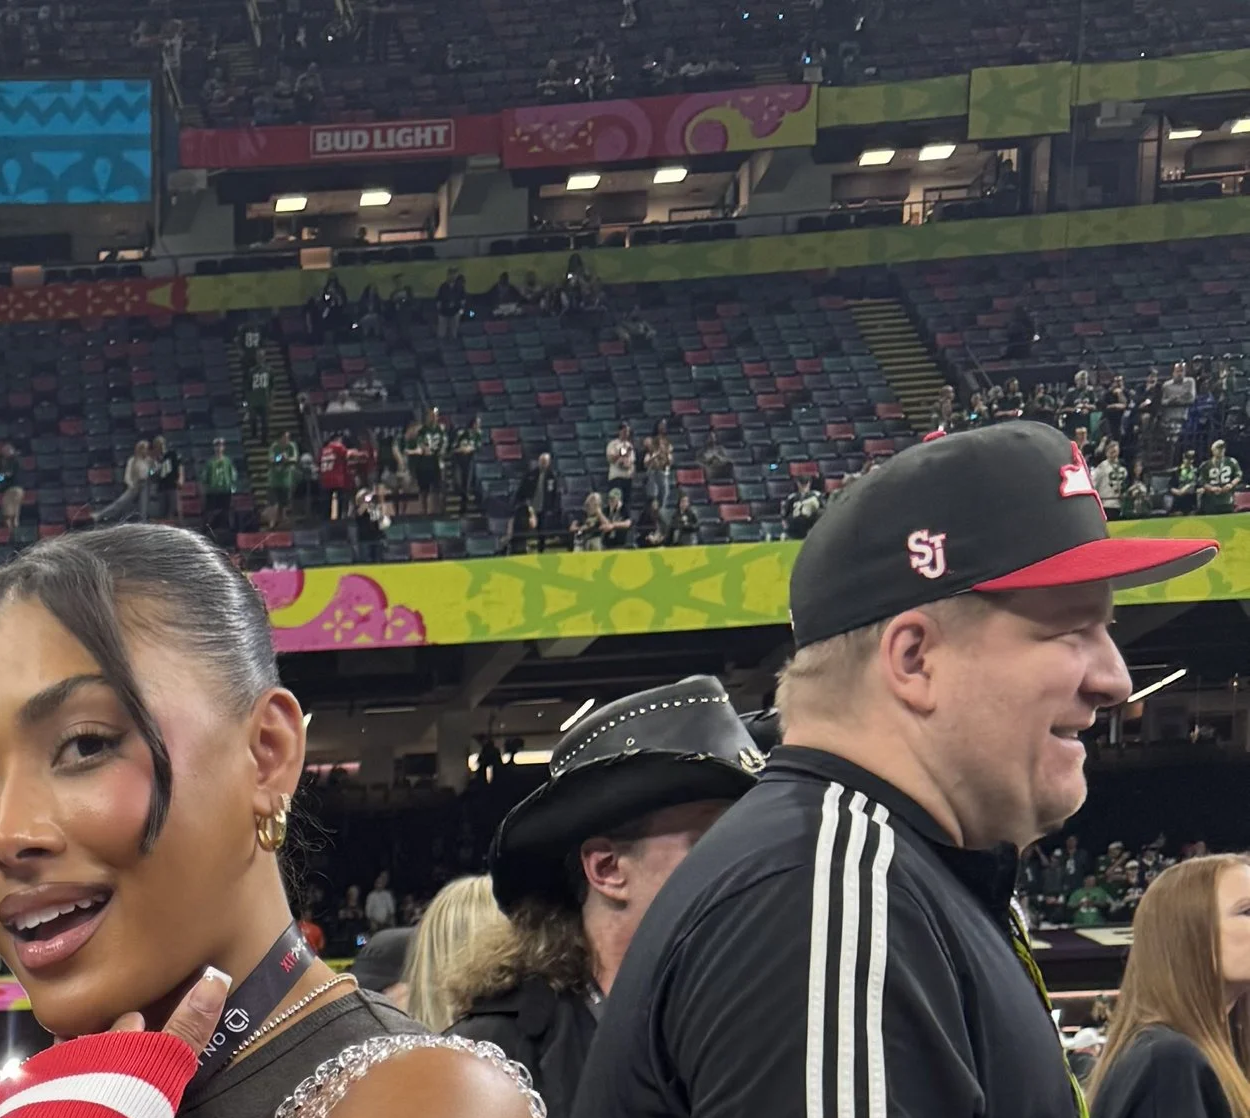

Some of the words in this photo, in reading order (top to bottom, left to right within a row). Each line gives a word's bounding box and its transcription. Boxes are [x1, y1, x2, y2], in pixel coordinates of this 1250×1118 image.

[315, 130, 369, 152] BUD
[373, 125, 449, 149] LIGHT
[1208, 465, 1231, 485] 92
[907, 529, 947, 579] SJ
